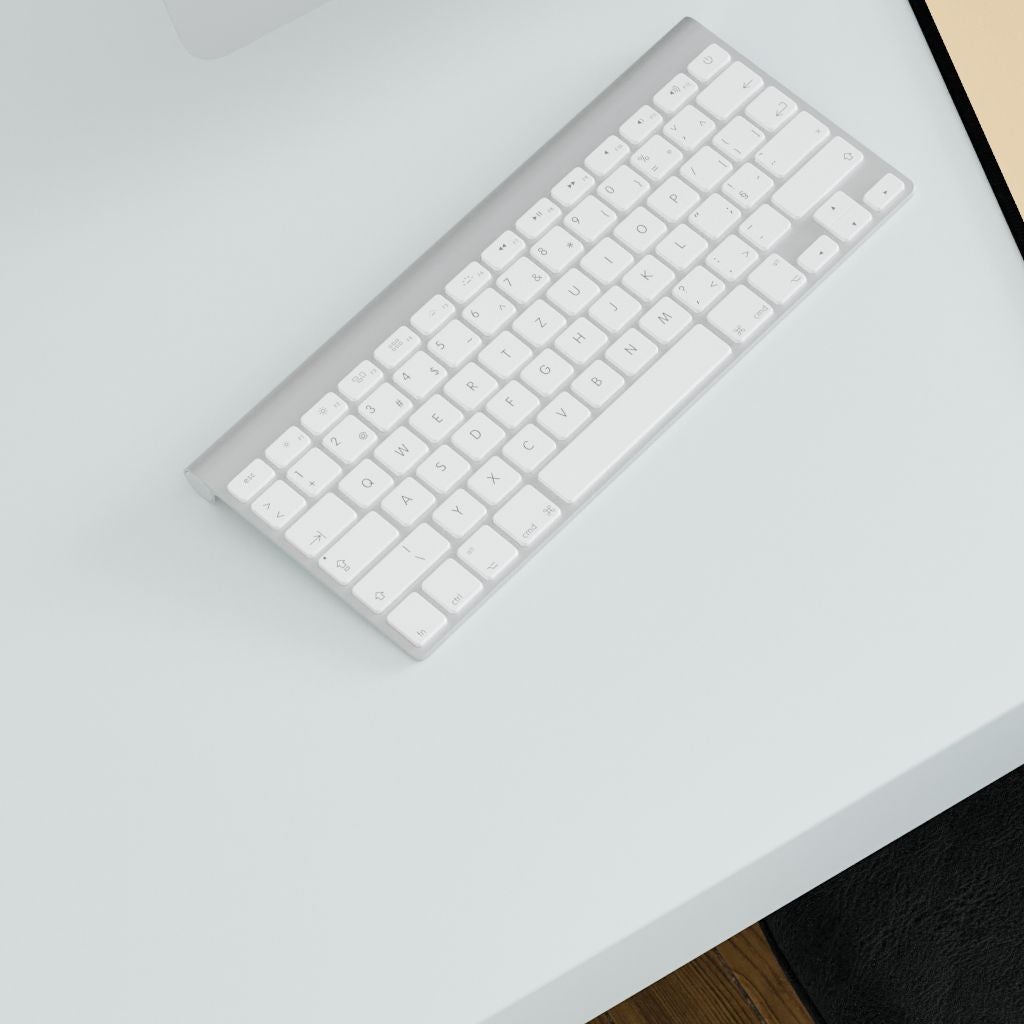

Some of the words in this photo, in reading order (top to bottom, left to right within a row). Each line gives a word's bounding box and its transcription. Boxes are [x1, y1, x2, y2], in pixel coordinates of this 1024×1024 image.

[604, 185, 615, 195] 0
[669, 194, 678, 203] P
[571, 216, 581, 226] 9
[635, 224, 647, 233] O
[538, 247, 548, 256] 8
[531, 273, 543, 283] &
[640, 270, 653, 280] K
[502, 278, 512, 288] 7
[568, 284, 582, 296] U
[609, 302, 618, 311] J
[470, 309, 480, 319] 6
[753, 305, 769, 320] cmd
[535, 317, 547, 328] Z
[658, 312, 672, 325] M
[572, 332, 586, 344] H
[435, 341, 446, 351] 5
[624, 344, 637, 355] N
[500, 349, 511, 358] T
[540, 364, 552, 376] G
[402, 372, 411, 382] 4
[591, 376, 602, 387] B
[466, 381, 478, 391] R
[505, 397, 514, 407] F
[364, 404, 375, 415] 3
[556, 408, 567, 417] V
[432, 413, 443, 423] E
[359, 430, 368, 440] @
[470, 428, 481, 440] D
[329, 437, 342, 448] 2
[521, 441, 534, 450] C
[394, 443, 409, 456] W
[436, 462, 446, 471] S
[293, 470, 304, 479] 1
[487, 472, 501, 485] X
[361, 478, 376, 488] Q
[401, 496, 413, 506] A
[451, 505, 463, 515] Y
[522, 523, 538, 539] cmd
[451, 593, 463, 606] ctrl
